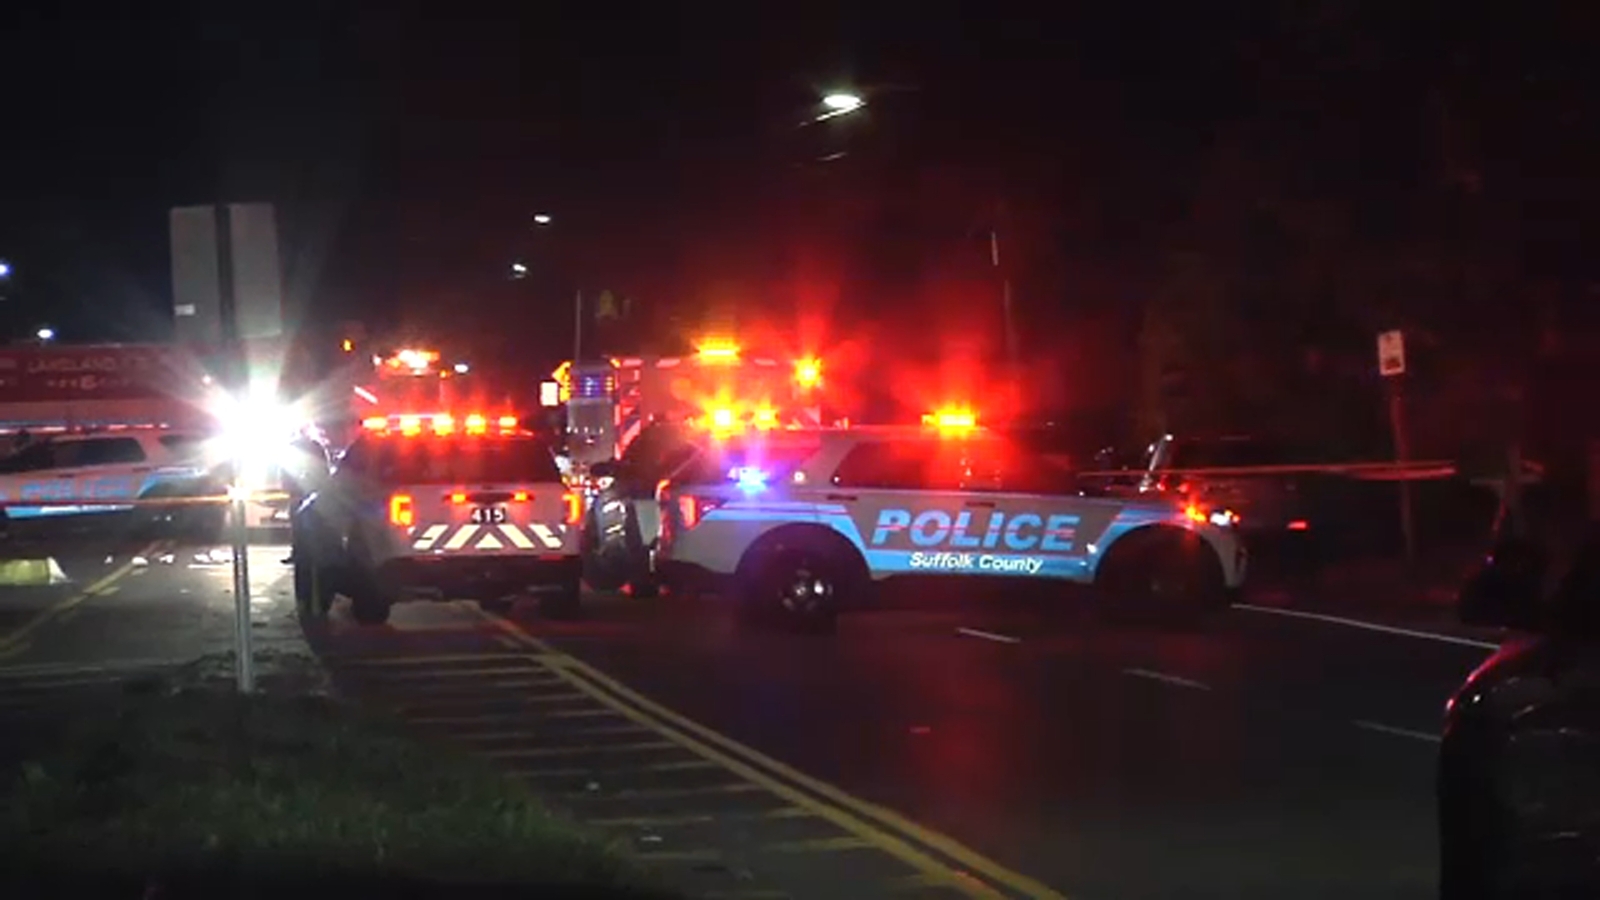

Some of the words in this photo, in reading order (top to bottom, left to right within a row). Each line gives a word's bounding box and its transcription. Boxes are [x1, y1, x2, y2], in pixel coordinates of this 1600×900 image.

[20, 478, 131, 501] POLICE
[472, 508, 504, 523] 415
[872, 509, 1080, 550] POLICE
[910, 552, 974, 569] Suffolk
[979, 555, 1043, 574] County
